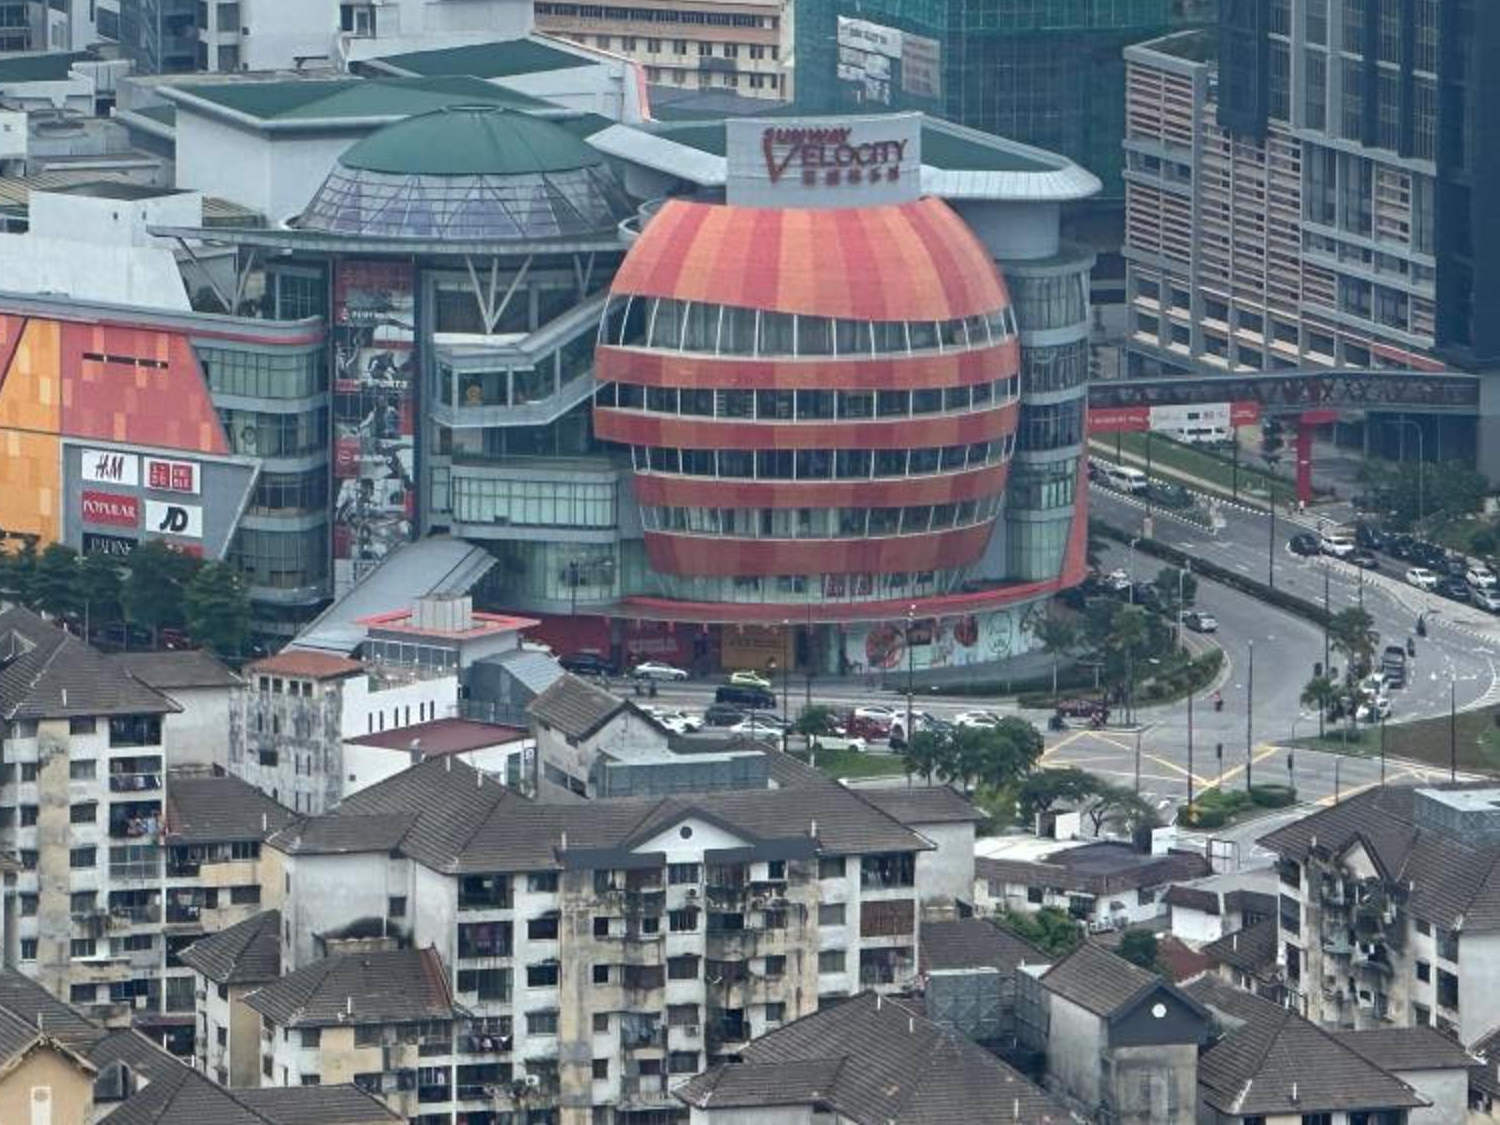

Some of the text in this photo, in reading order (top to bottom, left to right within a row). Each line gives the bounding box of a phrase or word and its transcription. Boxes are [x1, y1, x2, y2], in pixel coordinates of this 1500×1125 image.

[763, 127, 852, 145] SUNWAY
[763, 137, 908, 183] VELOCITY
[83, 499, 135, 518] POPULAR
[160, 507, 188, 531] JD
